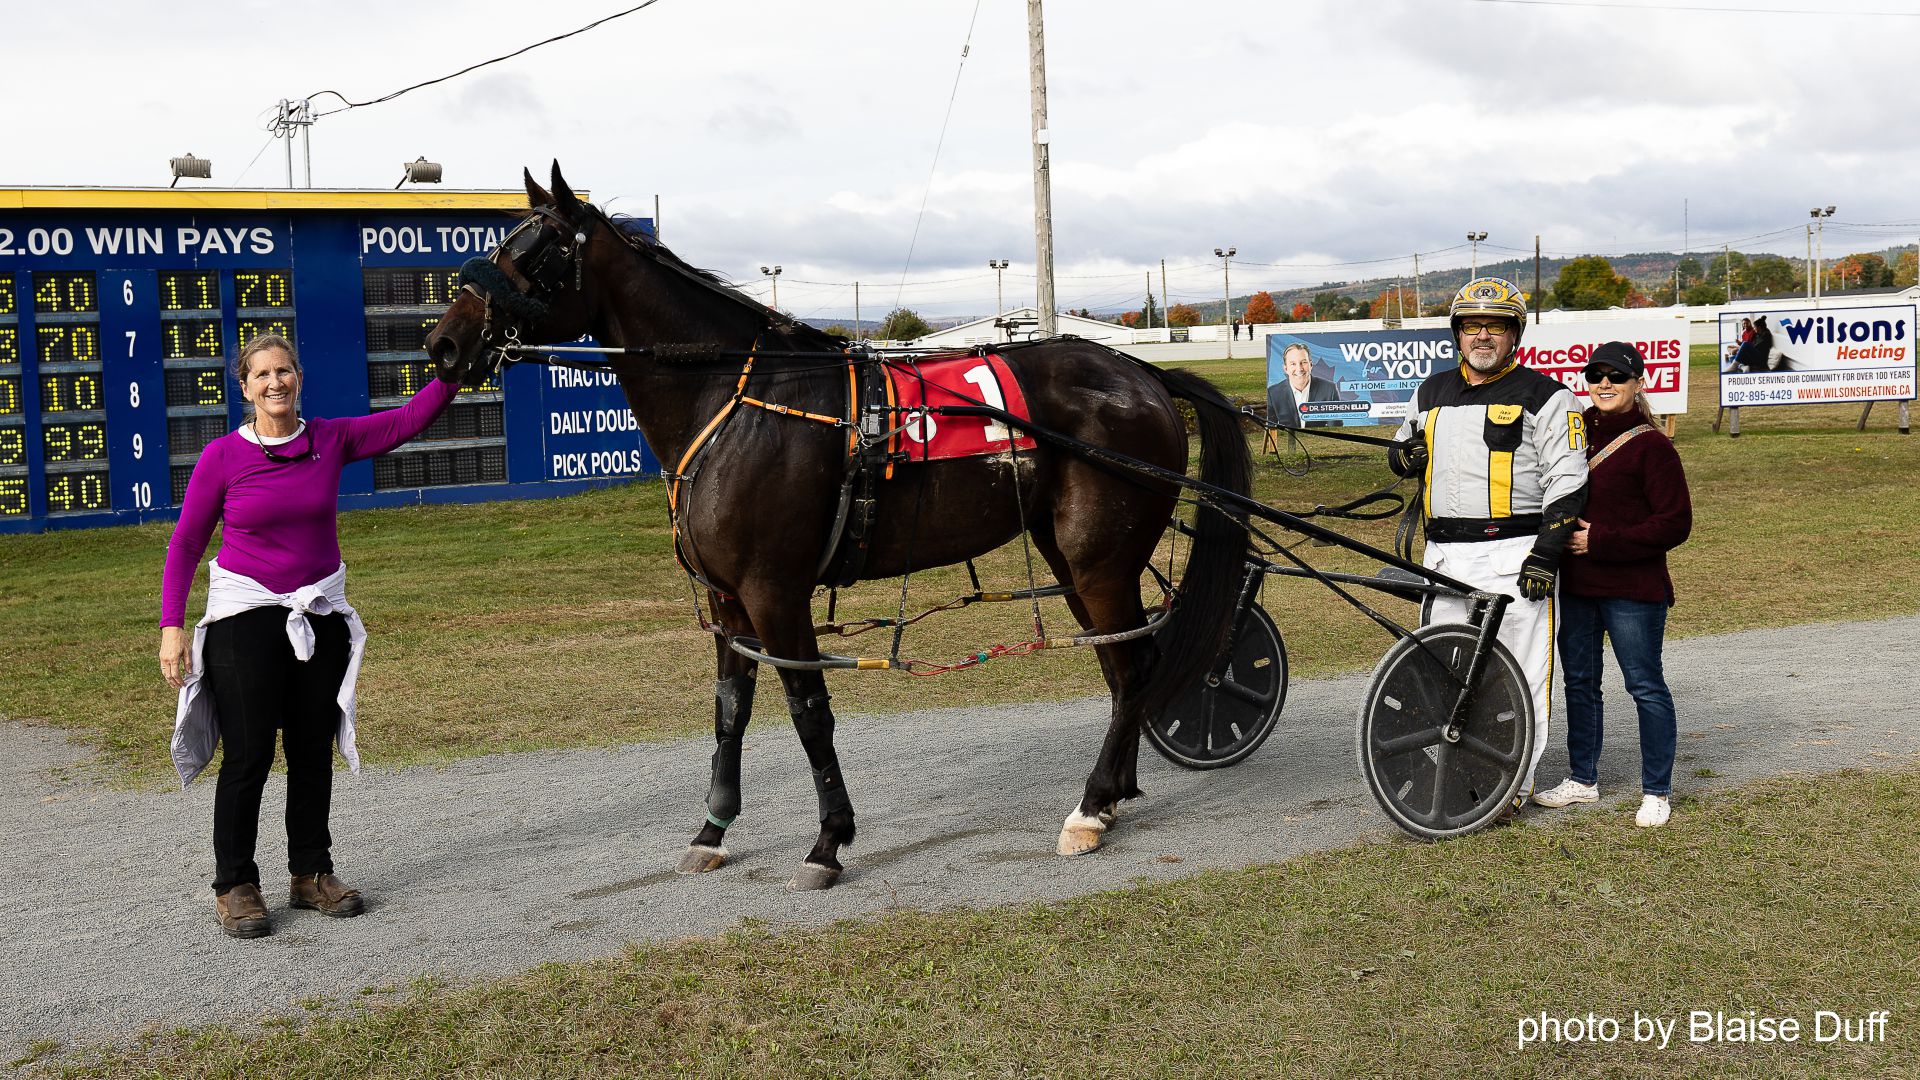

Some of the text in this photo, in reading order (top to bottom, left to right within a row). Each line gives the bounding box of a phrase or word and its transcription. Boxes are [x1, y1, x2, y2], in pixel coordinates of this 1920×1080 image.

[85, 227, 164, 255] WIN
[177, 227, 275, 255] PAYS
[362, 226, 432, 254] POOL
[36, 277, 90, 312] 40
[123, 279, 134, 306] 6
[165, 274, 286, 310] 11 70
[38, 326, 93, 361] 70
[125, 330, 137, 358] 7
[169, 323, 219, 358] 14
[1785, 316, 1906, 345] Wilsons
[1339, 340, 1454, 362] WORKING
[1836, 343, 1906, 361] Heating
[1361, 359, 1432, 380] for YOU
[1728, 370, 1911, 386] PROUDLY SERVING OUR COMMUNITY FOR OVER 100 YEARS
[47, 376, 96, 411] 10
[129, 381, 140, 408] 8
[1349, 382, 1360, 390] AT
[1361, 381, 1386, 390] HOME
[1399, 381, 1408, 389] IN
[1728, 384, 1911, 402] 902-895-4429 WWW.WILSONSHEATING.CA
[963, 364, 1025, 442] 1
[551, 411, 593, 434] DAILY
[1566, 410, 1587, 451] R
[45, 425, 104, 461] 99
[132, 433, 144, 460] 9
[553, 449, 641, 477] PICK POOLS
[48, 474, 102, 511] 40
[132, 482, 152, 508] 10
